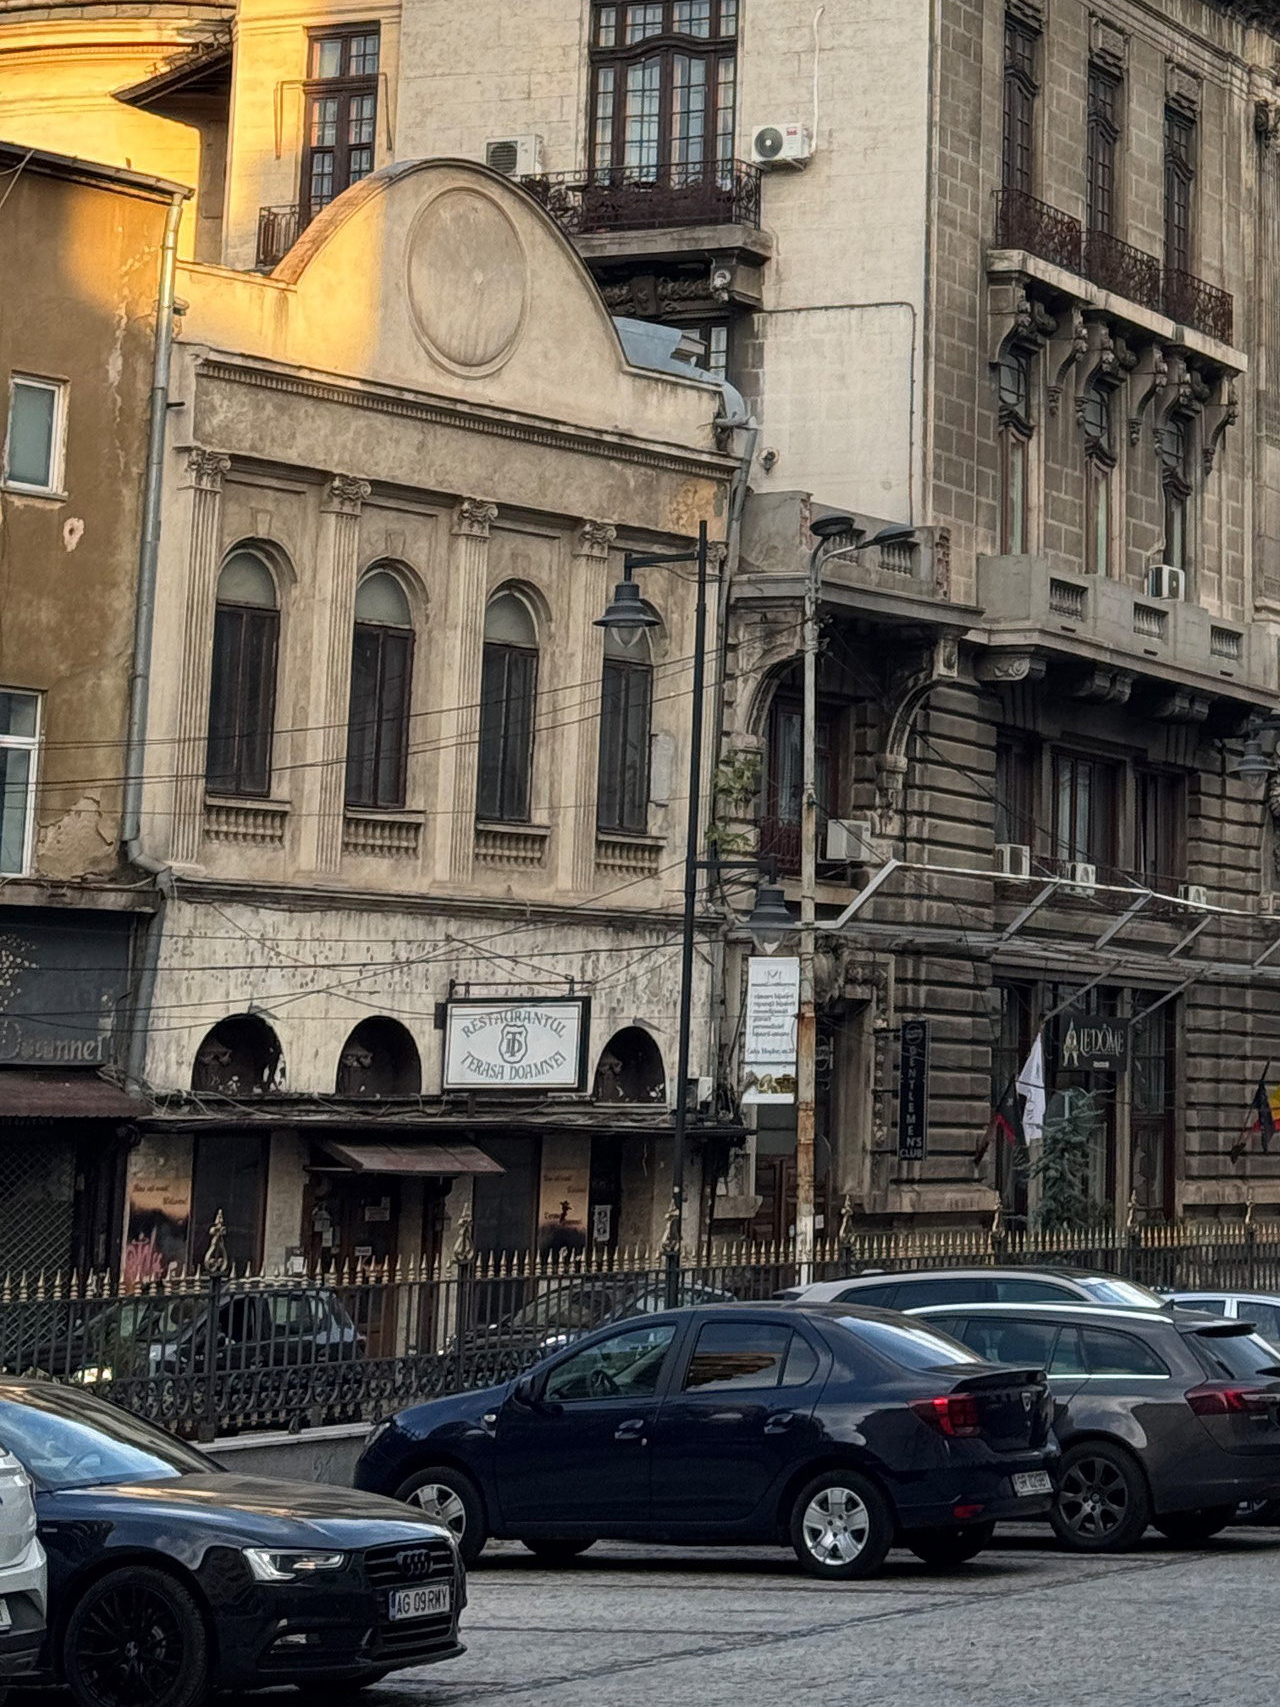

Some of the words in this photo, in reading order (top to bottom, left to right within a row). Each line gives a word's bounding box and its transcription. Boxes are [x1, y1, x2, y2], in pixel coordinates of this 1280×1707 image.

[460, 1009, 567, 1039] RESTAURANTUL
[460, 1051, 504, 1080] TERASA
[508, 1050, 567, 1080] DOAMNEI
[397, 1593, 410, 1615] AG
[414, 1591, 427, 1612] 09
